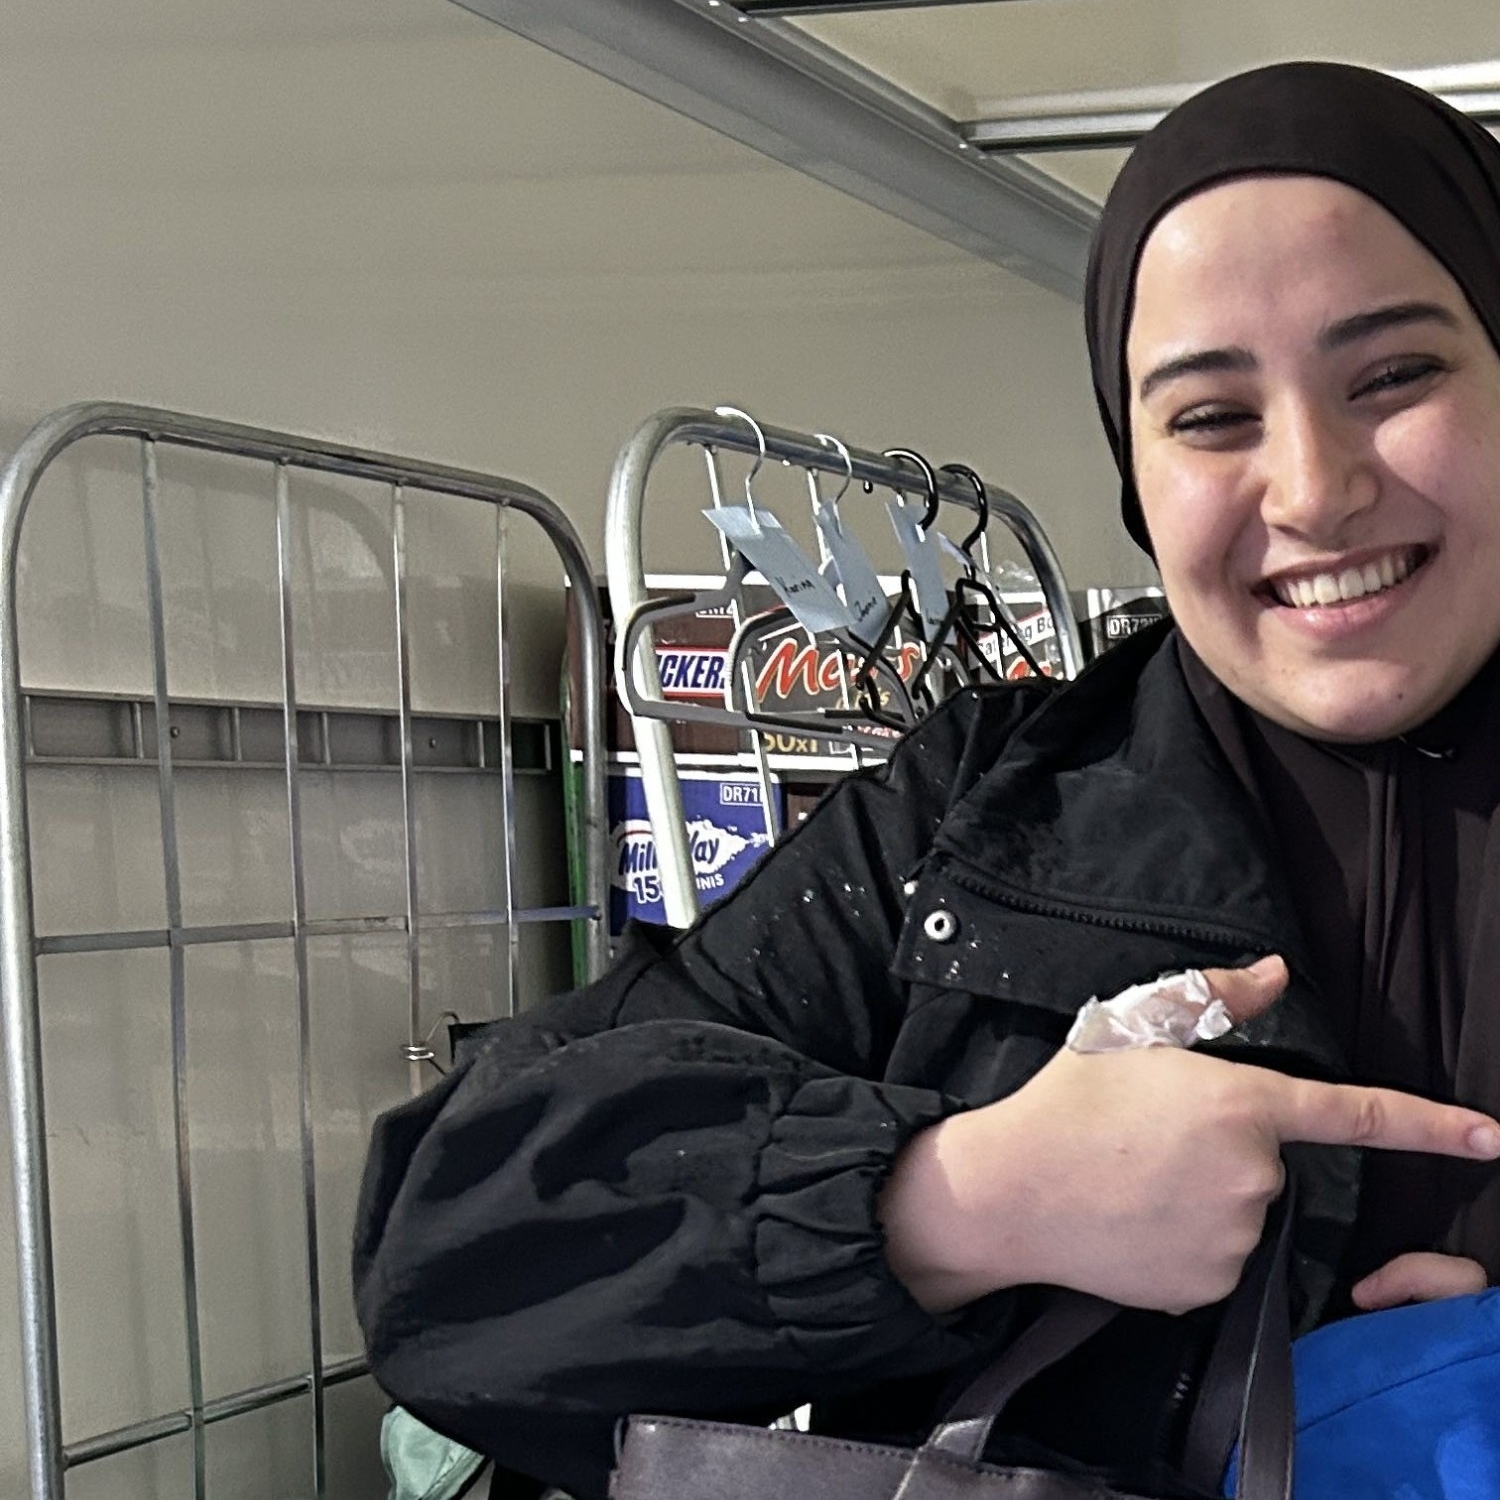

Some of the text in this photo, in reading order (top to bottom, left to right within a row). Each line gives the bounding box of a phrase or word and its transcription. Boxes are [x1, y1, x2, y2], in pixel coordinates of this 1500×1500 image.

[1036, 610, 1056, 634] Bo
[656, 654, 725, 690] CKER
[723, 785, 760, 803] DR71
[618, 839, 658, 876] Mil
[633, 873, 725, 904] 15 INIS
